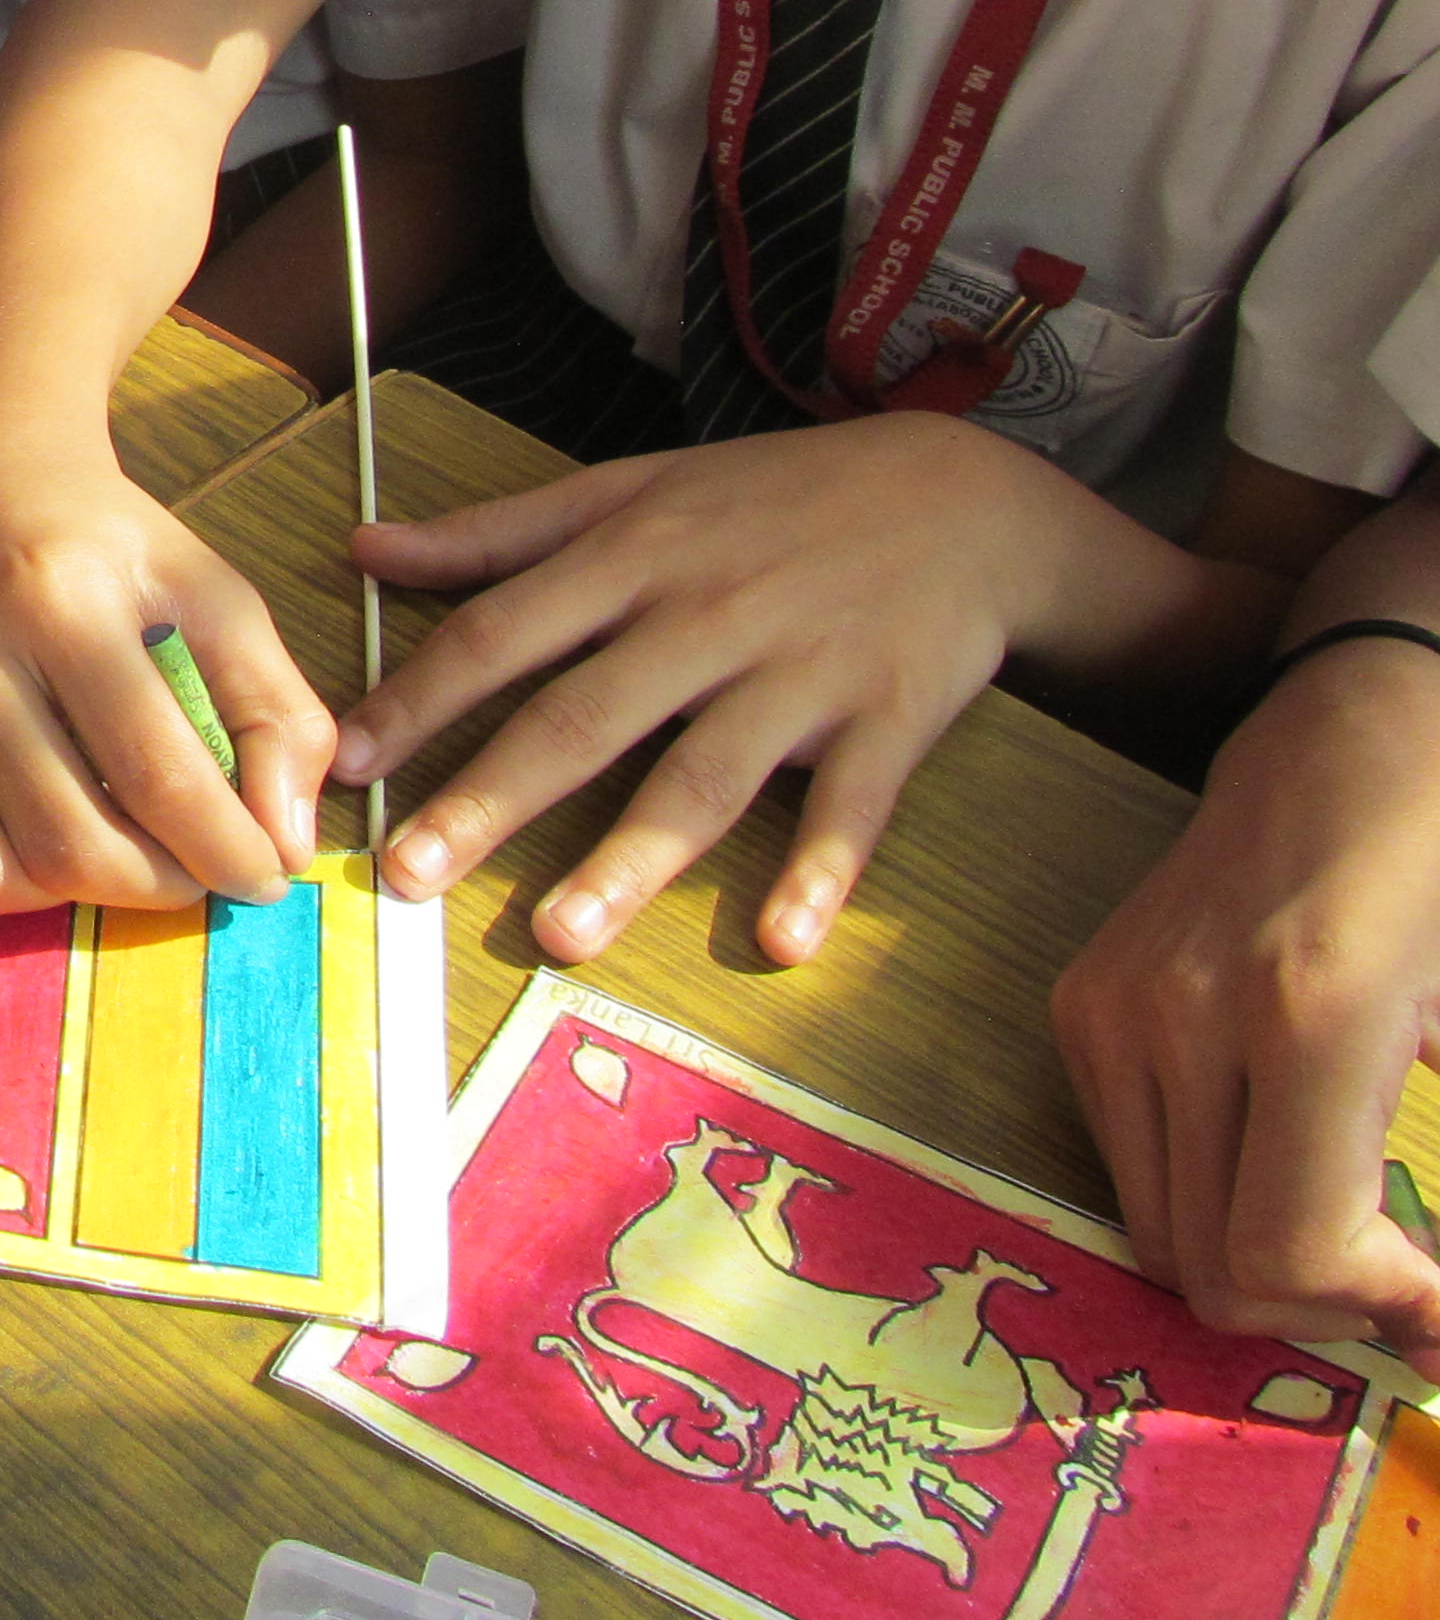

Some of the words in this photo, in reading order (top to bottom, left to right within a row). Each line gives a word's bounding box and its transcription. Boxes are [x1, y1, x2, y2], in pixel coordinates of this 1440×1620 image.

[722, 24, 755, 124] PUBLIC
[899, 137, 963, 234] PUBLIC
[839, 238, 911, 340] SCHOOL
[549, 982, 652, 1044] Lanka
